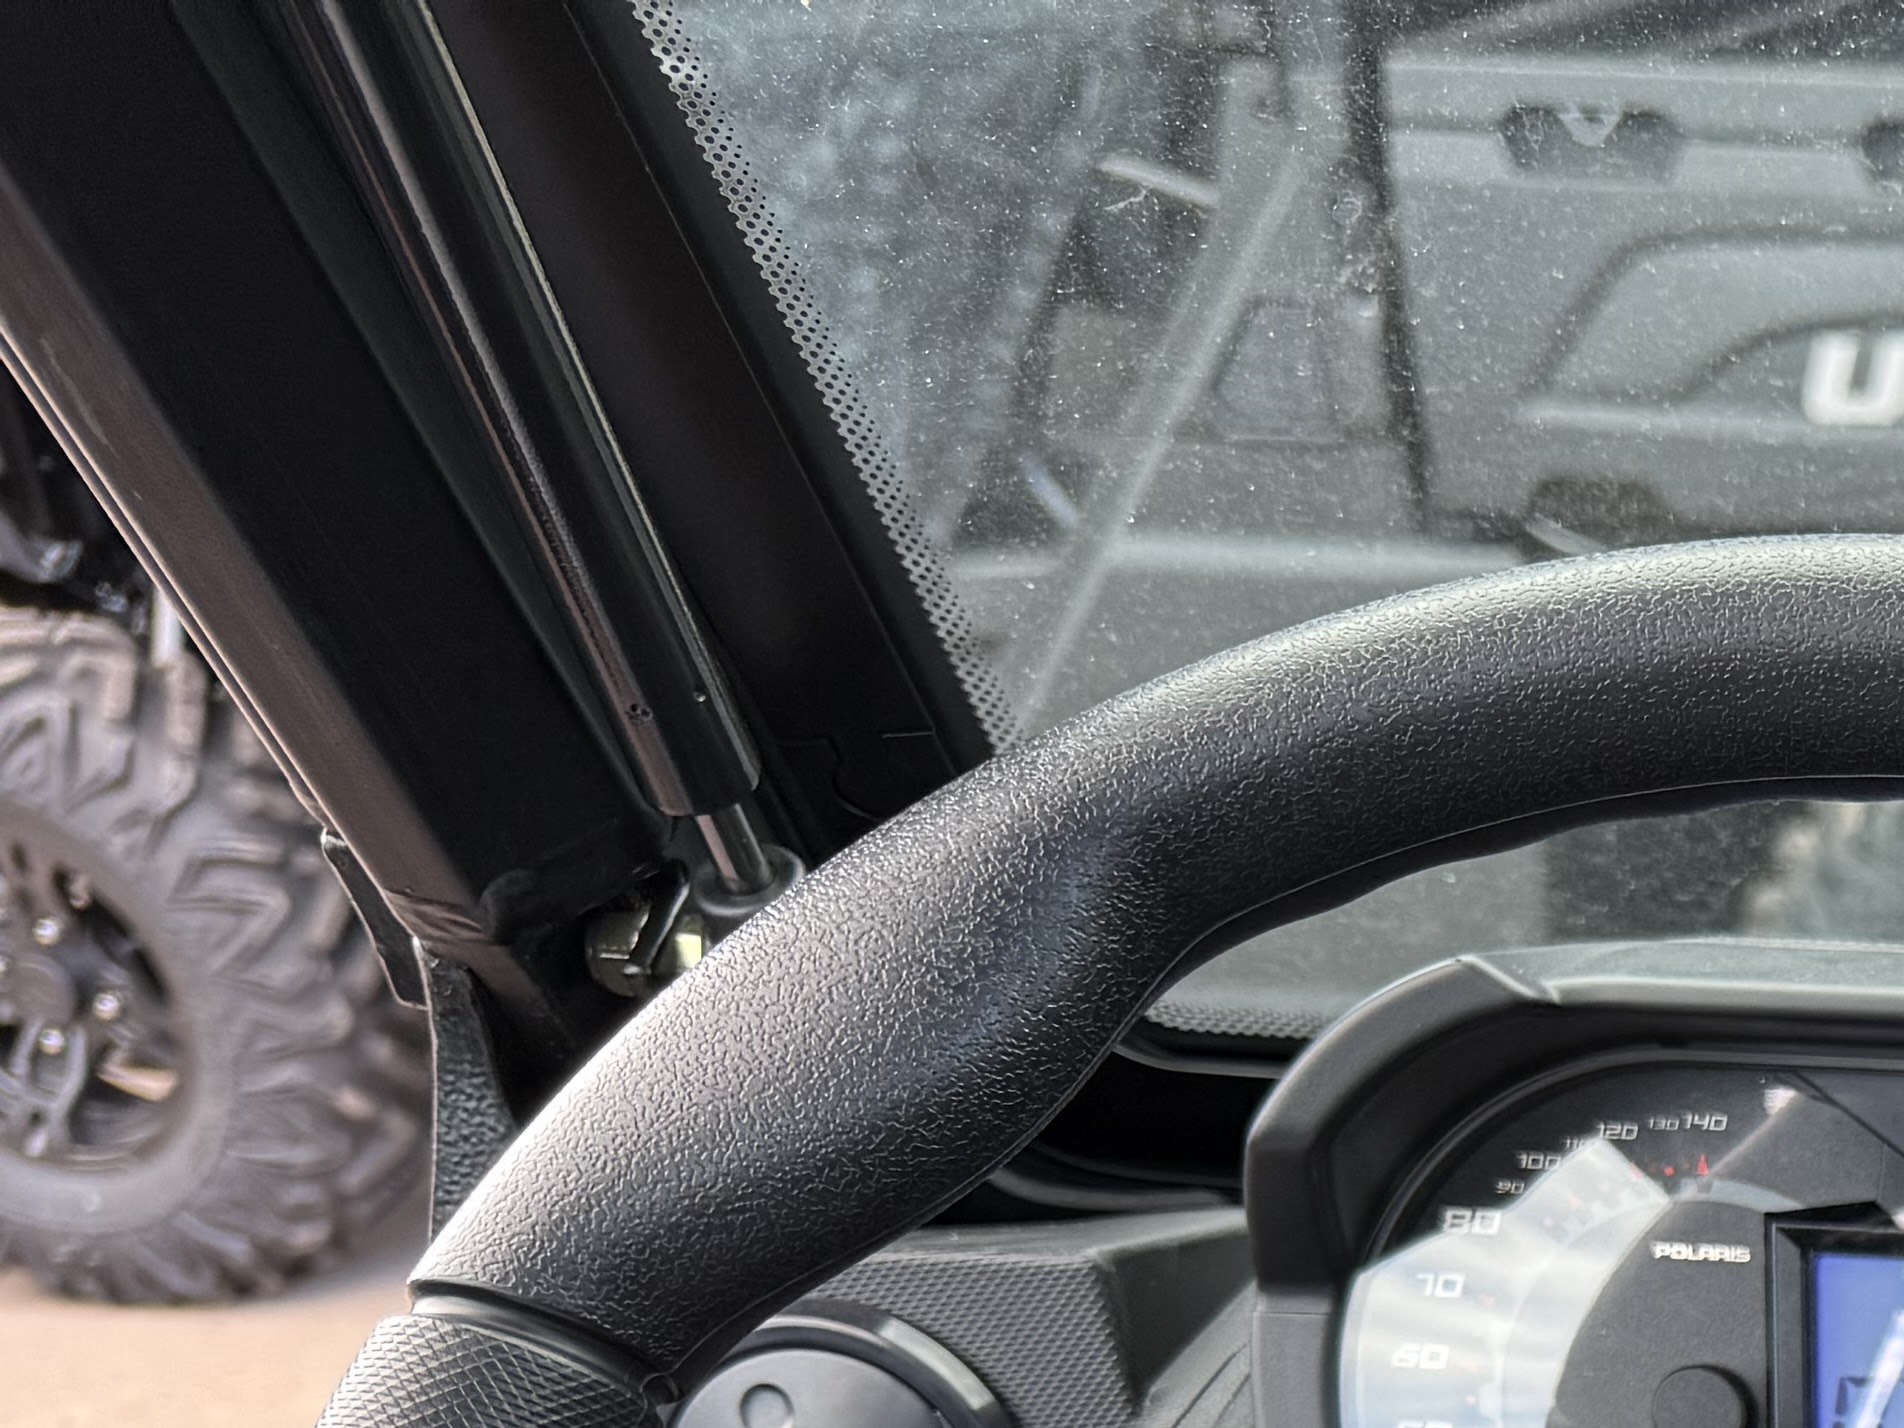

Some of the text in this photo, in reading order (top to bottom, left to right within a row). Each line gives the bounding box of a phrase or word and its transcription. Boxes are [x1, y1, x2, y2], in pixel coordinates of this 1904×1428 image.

[1597, 1121, 1638, 1141] 120
[1648, 1118, 1680, 1131] 130
[1682, 1113, 1728, 1132] 140
[1515, 1152, 1563, 1171] 100
[1441, 1209, 1501, 1236] 80
[1653, 1241, 1751, 1263] POLARIS
[1415, 1272, 1465, 1299] 70
[1391, 1343, 1450, 1370] 60
